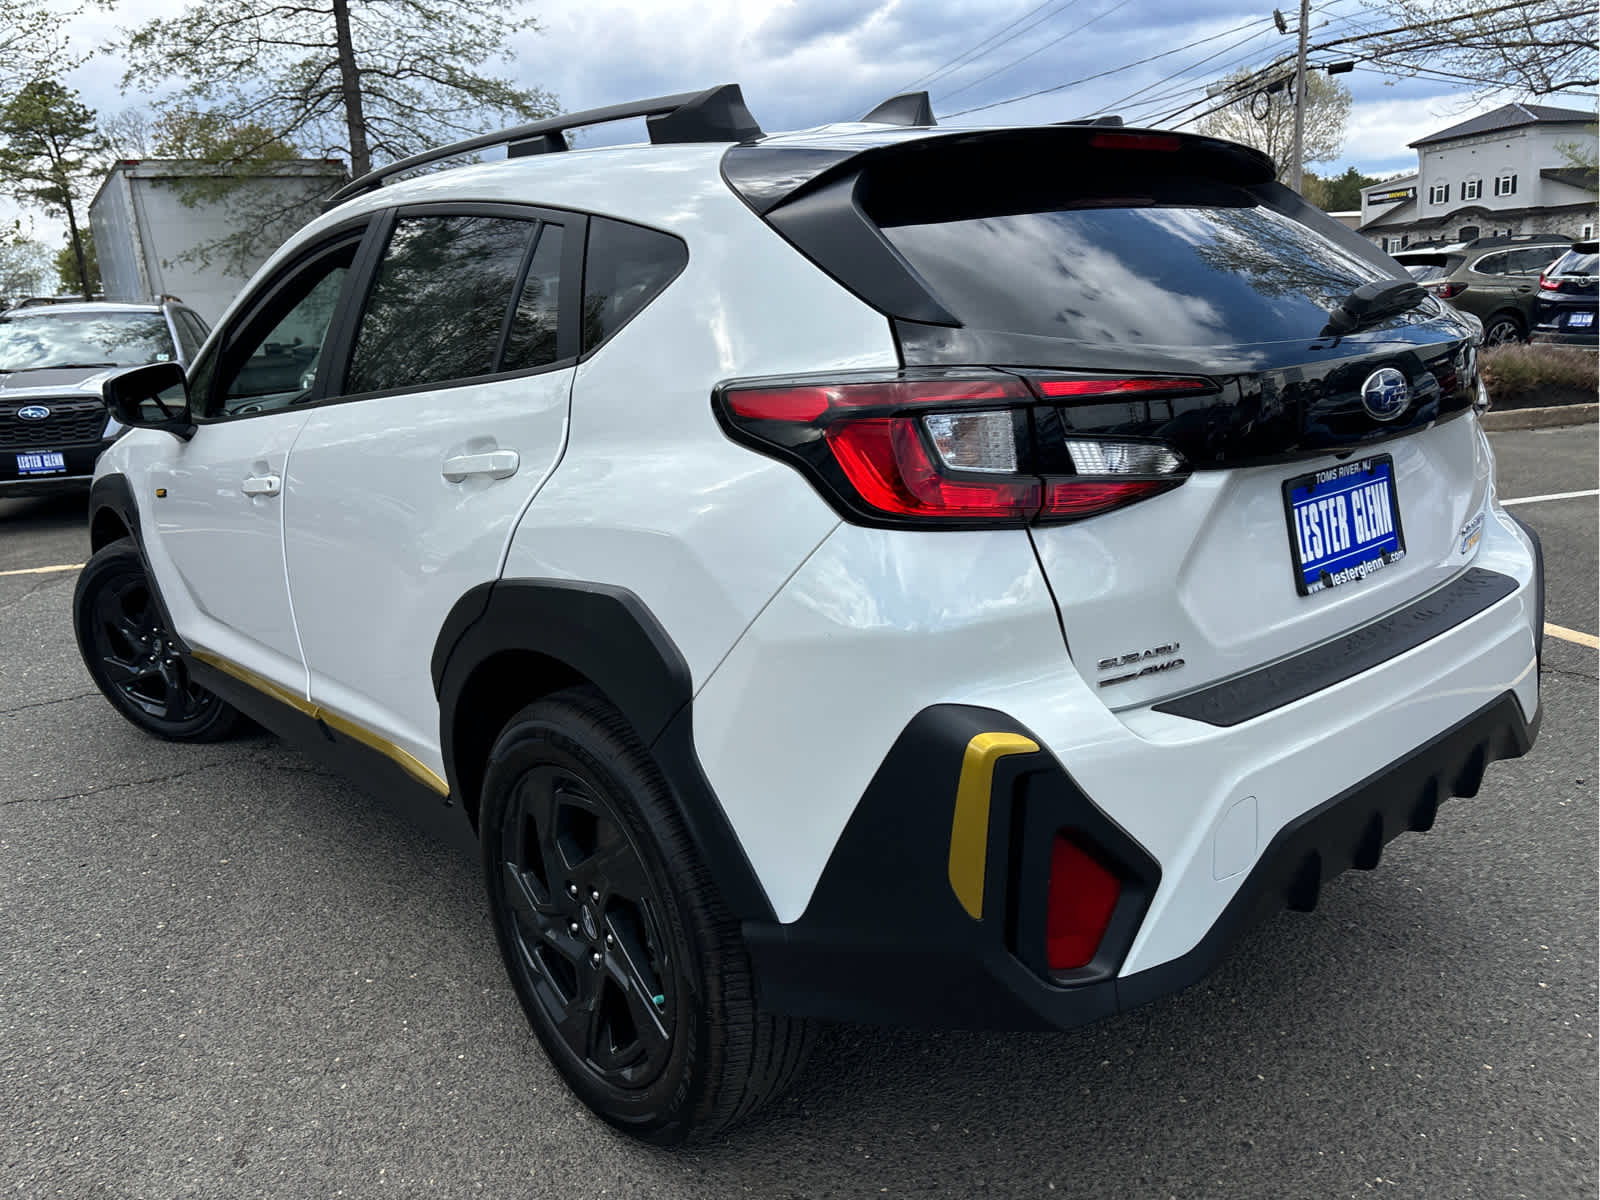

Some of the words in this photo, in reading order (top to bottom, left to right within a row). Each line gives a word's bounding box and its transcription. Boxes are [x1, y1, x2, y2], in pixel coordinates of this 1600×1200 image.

[17, 455, 43, 469] LESTER
[42, 453, 65, 467] GLENN
[1315, 468, 1337, 484] TOMS
[1362, 459, 1372, 472] NJ
[1294, 494, 1350, 564] LESTER
[1351, 481, 1393, 544] GLENN
[1330, 557, 1385, 586] lesterglenn
[1097, 641, 1180, 670] SUBARU
[1138, 658, 1185, 677] AWD
